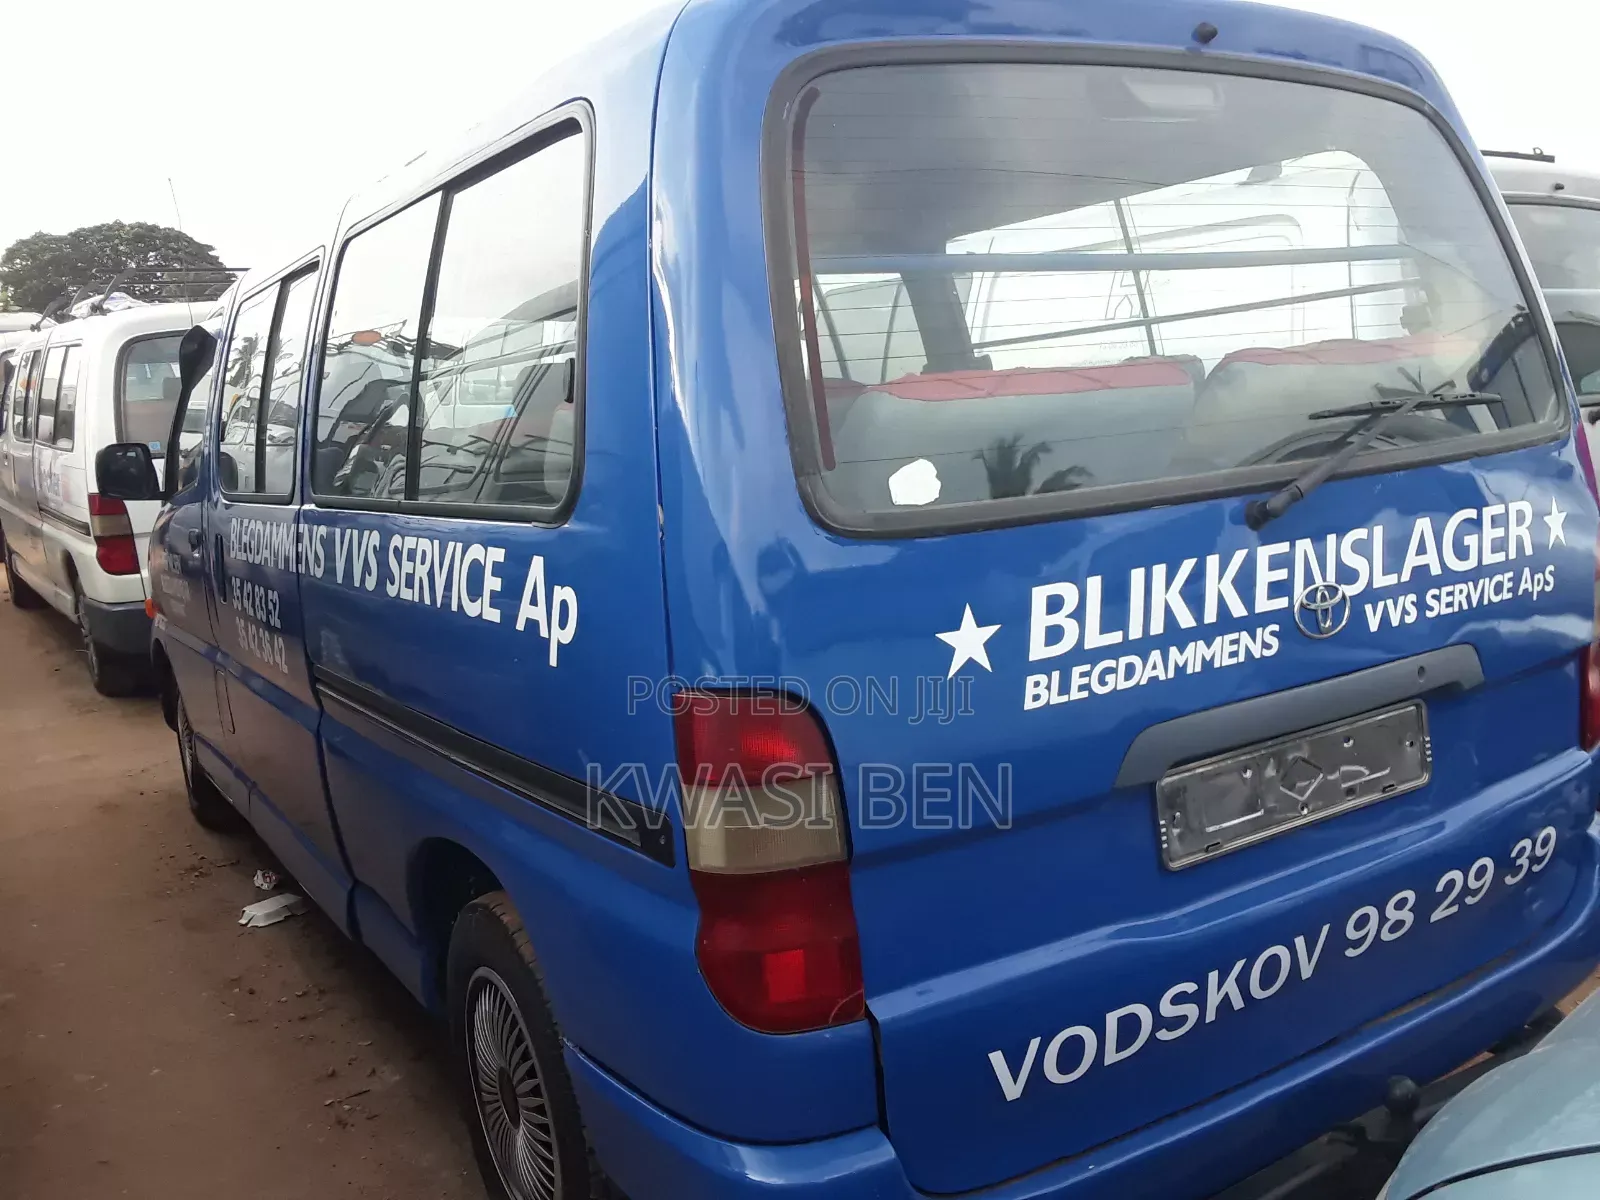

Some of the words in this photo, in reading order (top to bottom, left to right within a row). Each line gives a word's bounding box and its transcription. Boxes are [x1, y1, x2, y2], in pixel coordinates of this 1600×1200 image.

[230, 517, 327, 579] BLEGDAMMENS
[335, 527, 380, 592] VVS
[386, 533, 506, 624] SERVICE
[515, 555, 578, 668] Ap
[243, 580, 254, 617] 42
[268, 589, 282, 629] 52
[1023, 623, 1280, 711] BLEGDAMMENS
[1364, 593, 1418, 633] VVS
[1425, 571, 1514, 619] SERVICE
[1028, 500, 1533, 661] BLIKKENSLAGER
[987, 924, 1331, 1102] VODSKOV
[1343, 889, 1416, 958] 98
[1429, 856, 1495, 923] 29
[1503, 826, 1558, 886] 39
